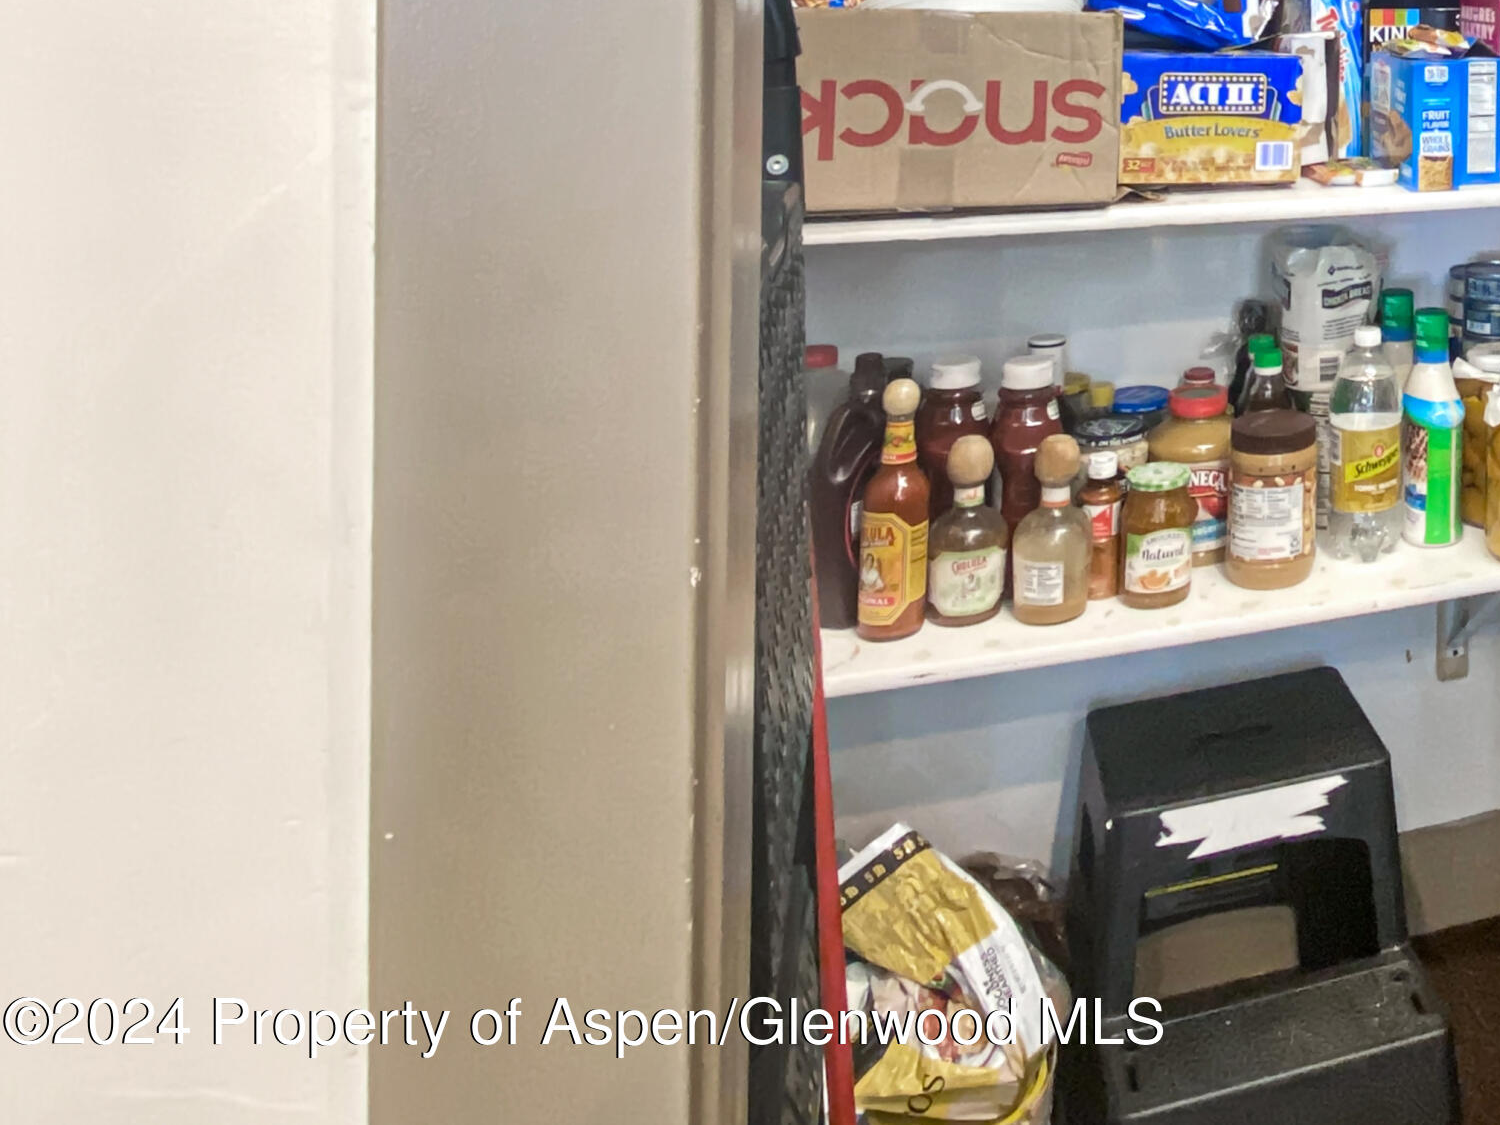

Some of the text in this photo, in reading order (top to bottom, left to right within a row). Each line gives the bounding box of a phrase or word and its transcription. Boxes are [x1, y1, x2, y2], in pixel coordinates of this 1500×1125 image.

[1170, 82, 1255, 106] ACT II
[1422, 110, 1450, 121] FRUIT
[1163, 124, 1212, 140] Butter
[1421, 135, 1451, 145] WHOLE
[1126, 159, 1141, 171] 32
[1187, 470, 1228, 491] NECA
[951, 556, 988, 573] CHOLULA
